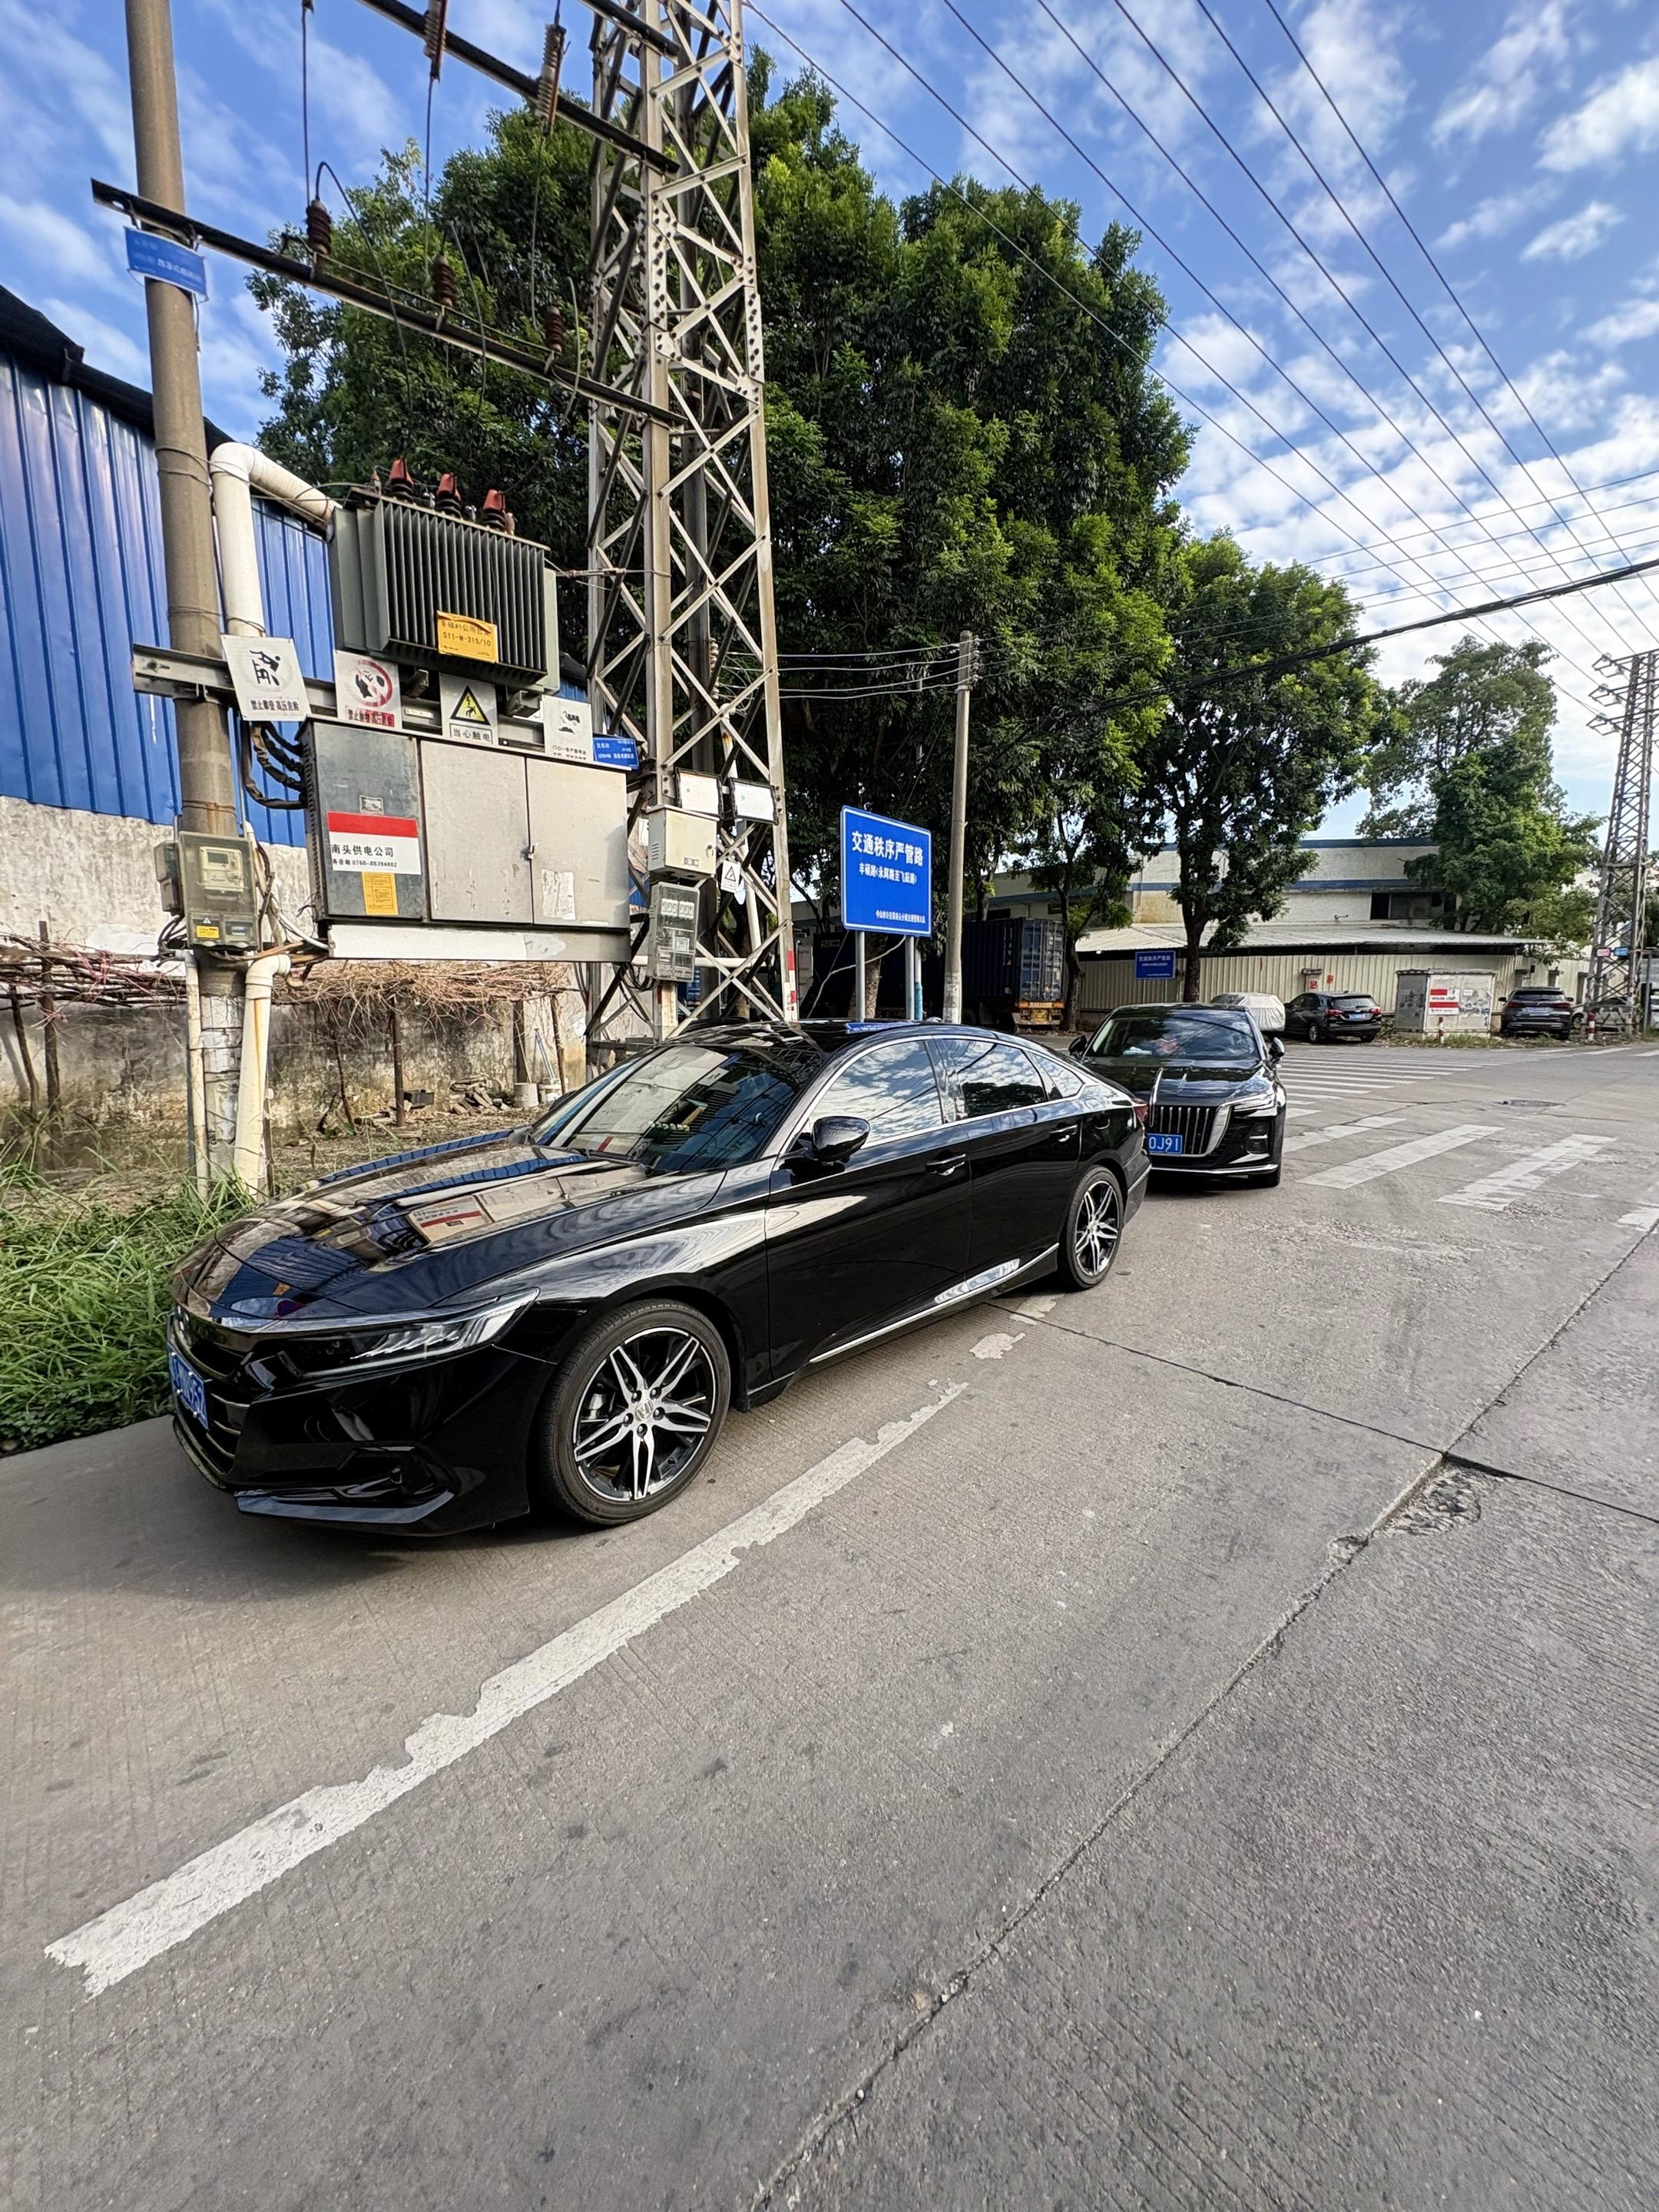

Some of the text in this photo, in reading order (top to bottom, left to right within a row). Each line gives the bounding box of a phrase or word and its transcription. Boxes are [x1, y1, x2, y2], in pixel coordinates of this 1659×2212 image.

[453, 727, 491, 742] 当心触电
[331, 844, 394, 857] 南头供电公司
[852, 831, 923, 866] 交通秩序严管路
